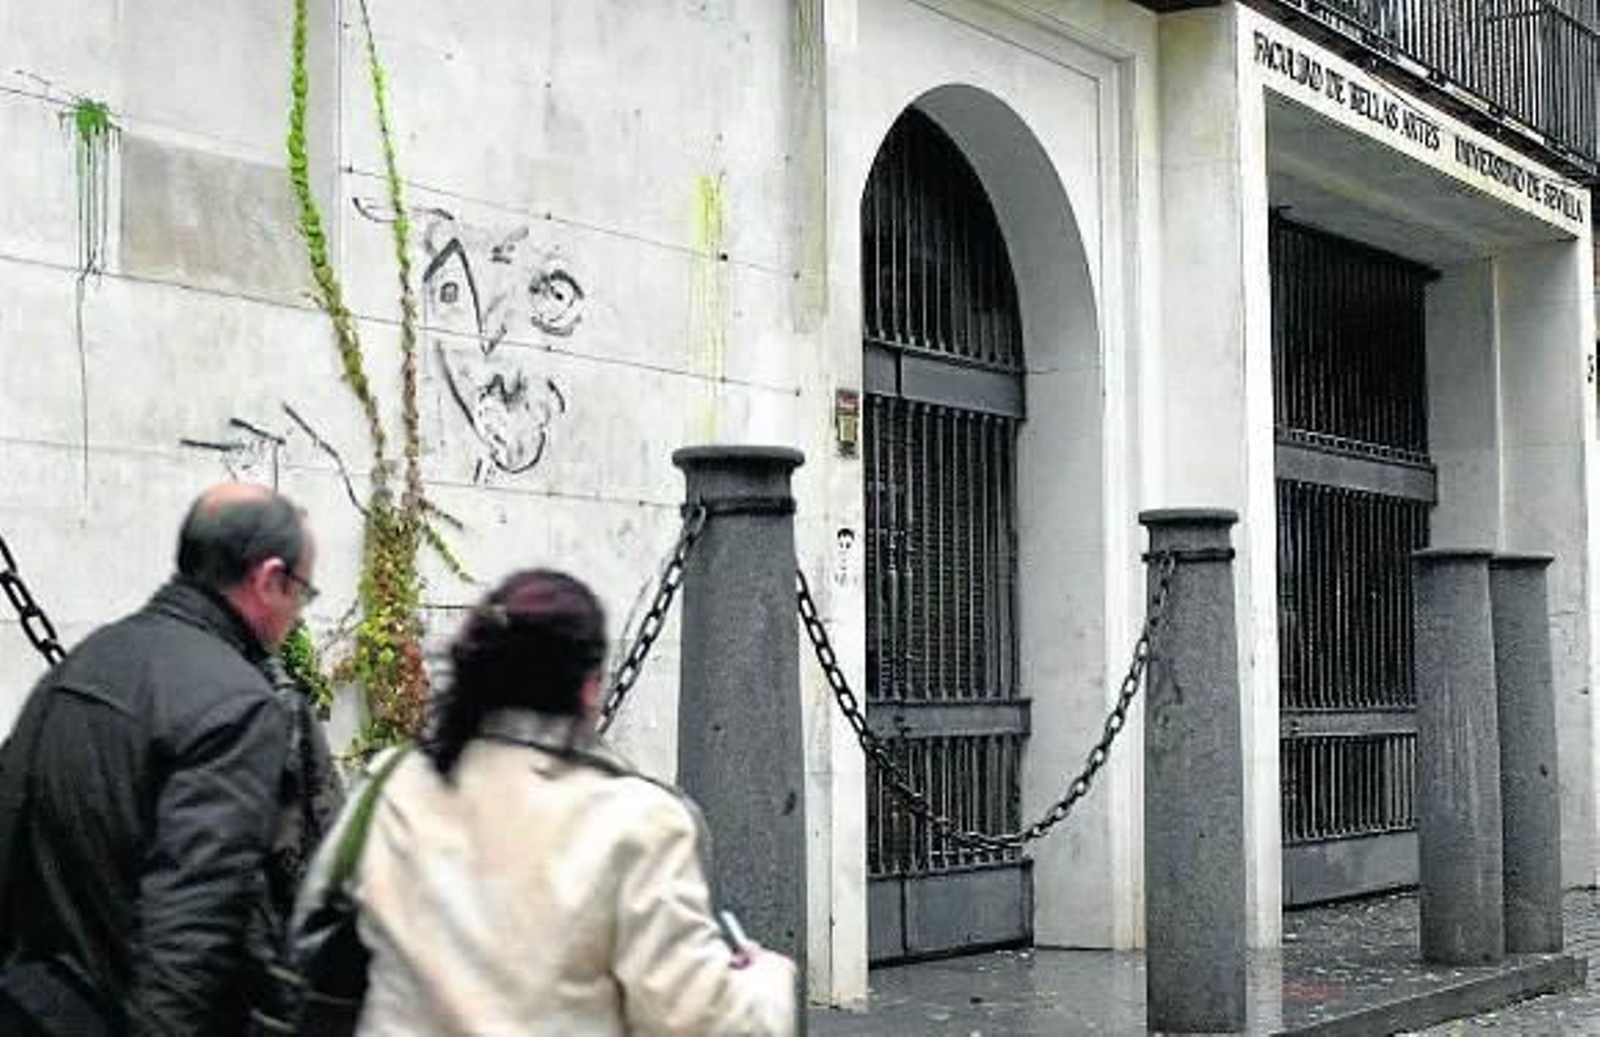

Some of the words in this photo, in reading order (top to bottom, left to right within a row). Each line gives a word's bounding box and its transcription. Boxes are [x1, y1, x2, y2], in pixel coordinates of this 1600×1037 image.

[1325, 67, 1346, 104] DE
[1348, 81, 1399, 130] BELLAS
[1400, 110, 1440, 151] ARTES
[1543, 182, 1584, 224] SEVILLA
